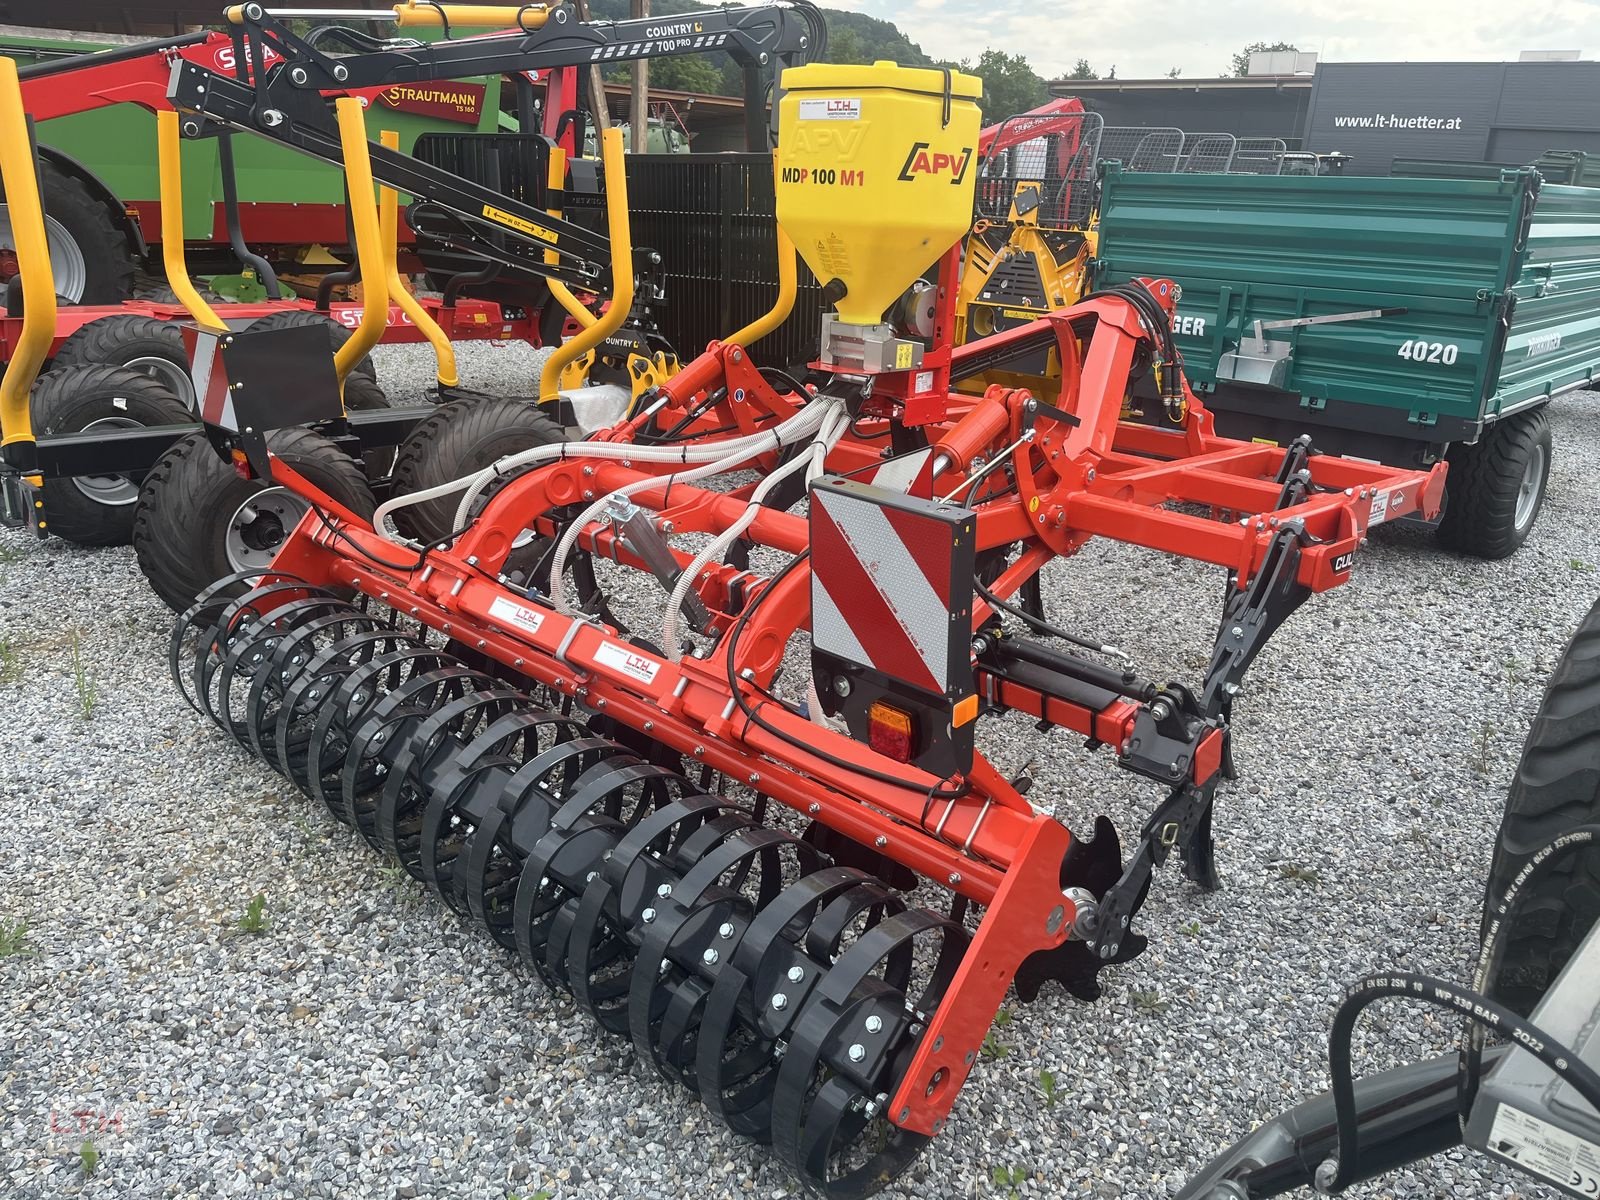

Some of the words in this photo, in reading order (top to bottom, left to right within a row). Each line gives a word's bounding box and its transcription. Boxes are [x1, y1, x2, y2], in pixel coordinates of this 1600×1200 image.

[646, 23, 692, 38] COUNTRY
[656, 40, 675, 52] 700
[676, 38, 691, 48] PRO
[389, 86, 476, 106] STRAUTMANN
[1335, 113, 1462, 130] www.lt-huetter.at
[782, 167, 808, 183] MDP
[811, 168, 836, 185] 100
[605, 337, 633, 347] OUNTRY
[1397, 339, 1459, 365] 4020
[1412, 981, 1424, 992] 10
[1434, 986, 1453, 1001] WP
[1452, 995, 1473, 1011] 330
[1473, 1004, 1501, 1025] BAR
